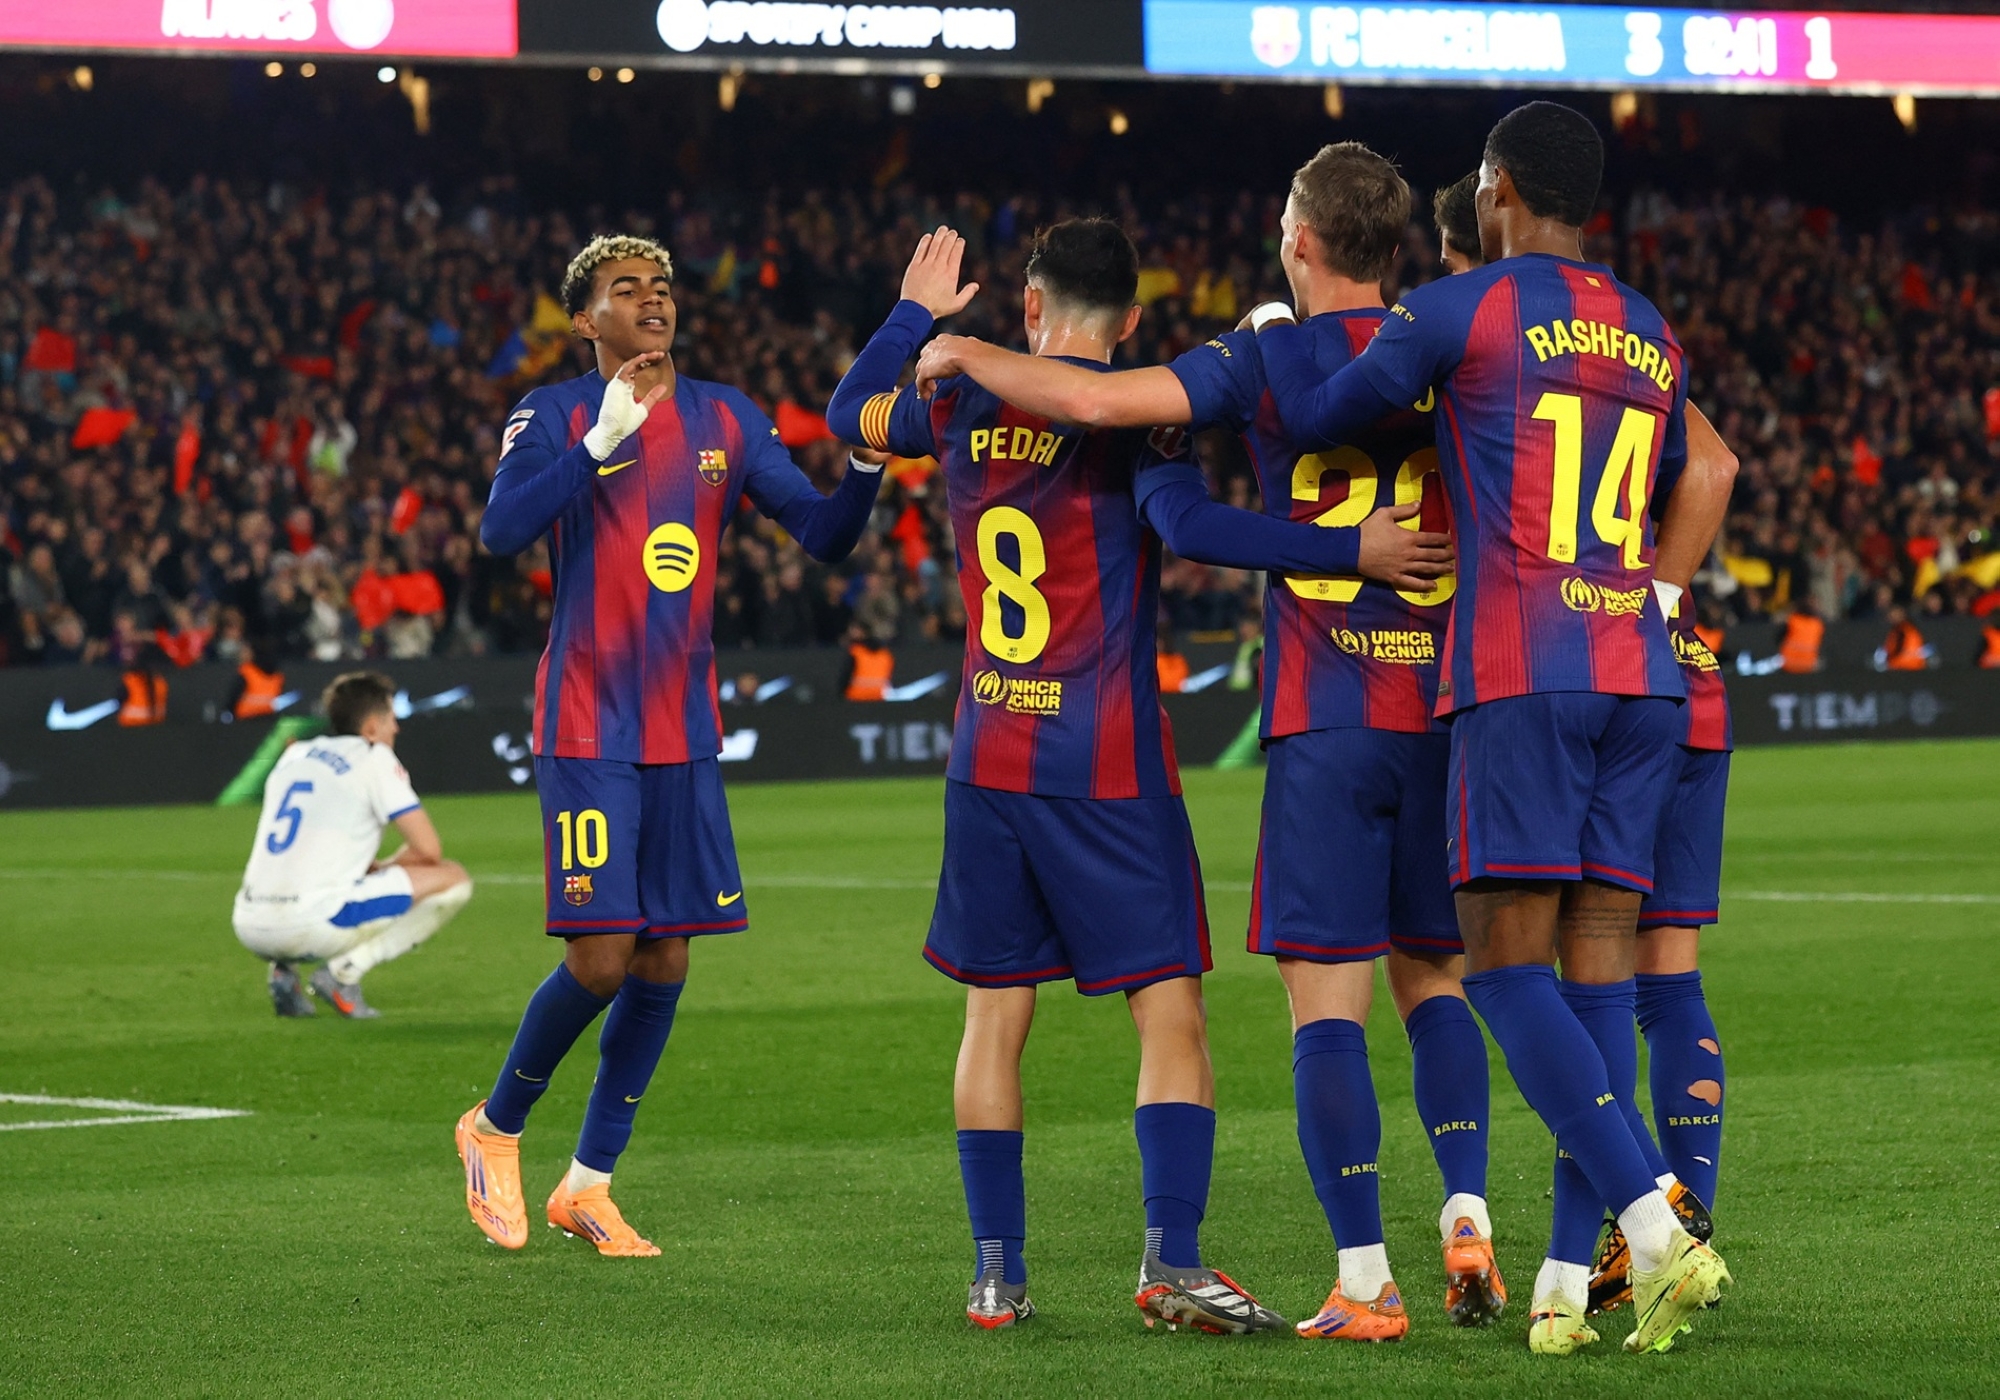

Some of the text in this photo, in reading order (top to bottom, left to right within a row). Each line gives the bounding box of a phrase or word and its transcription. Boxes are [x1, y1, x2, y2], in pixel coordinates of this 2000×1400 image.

[1310, 6, 1566, 71] FC BARCELONA
[1624, 12, 1664, 76] 3
[1804, 16, 1838, 80] 1
[1525, 319, 1674, 392] RASHFORD
[971, 427, 1064, 467] PEDRI
[1531, 392, 1655, 570] 14
[977, 505, 1050, 664] 8
[1371, 631, 1433, 645] UNHCR
[1373, 645, 1435, 658] ACNUR
[267, 782, 313, 854] 5
[556, 808, 609, 870] 10
[471, 1195, 508, 1236] F50
